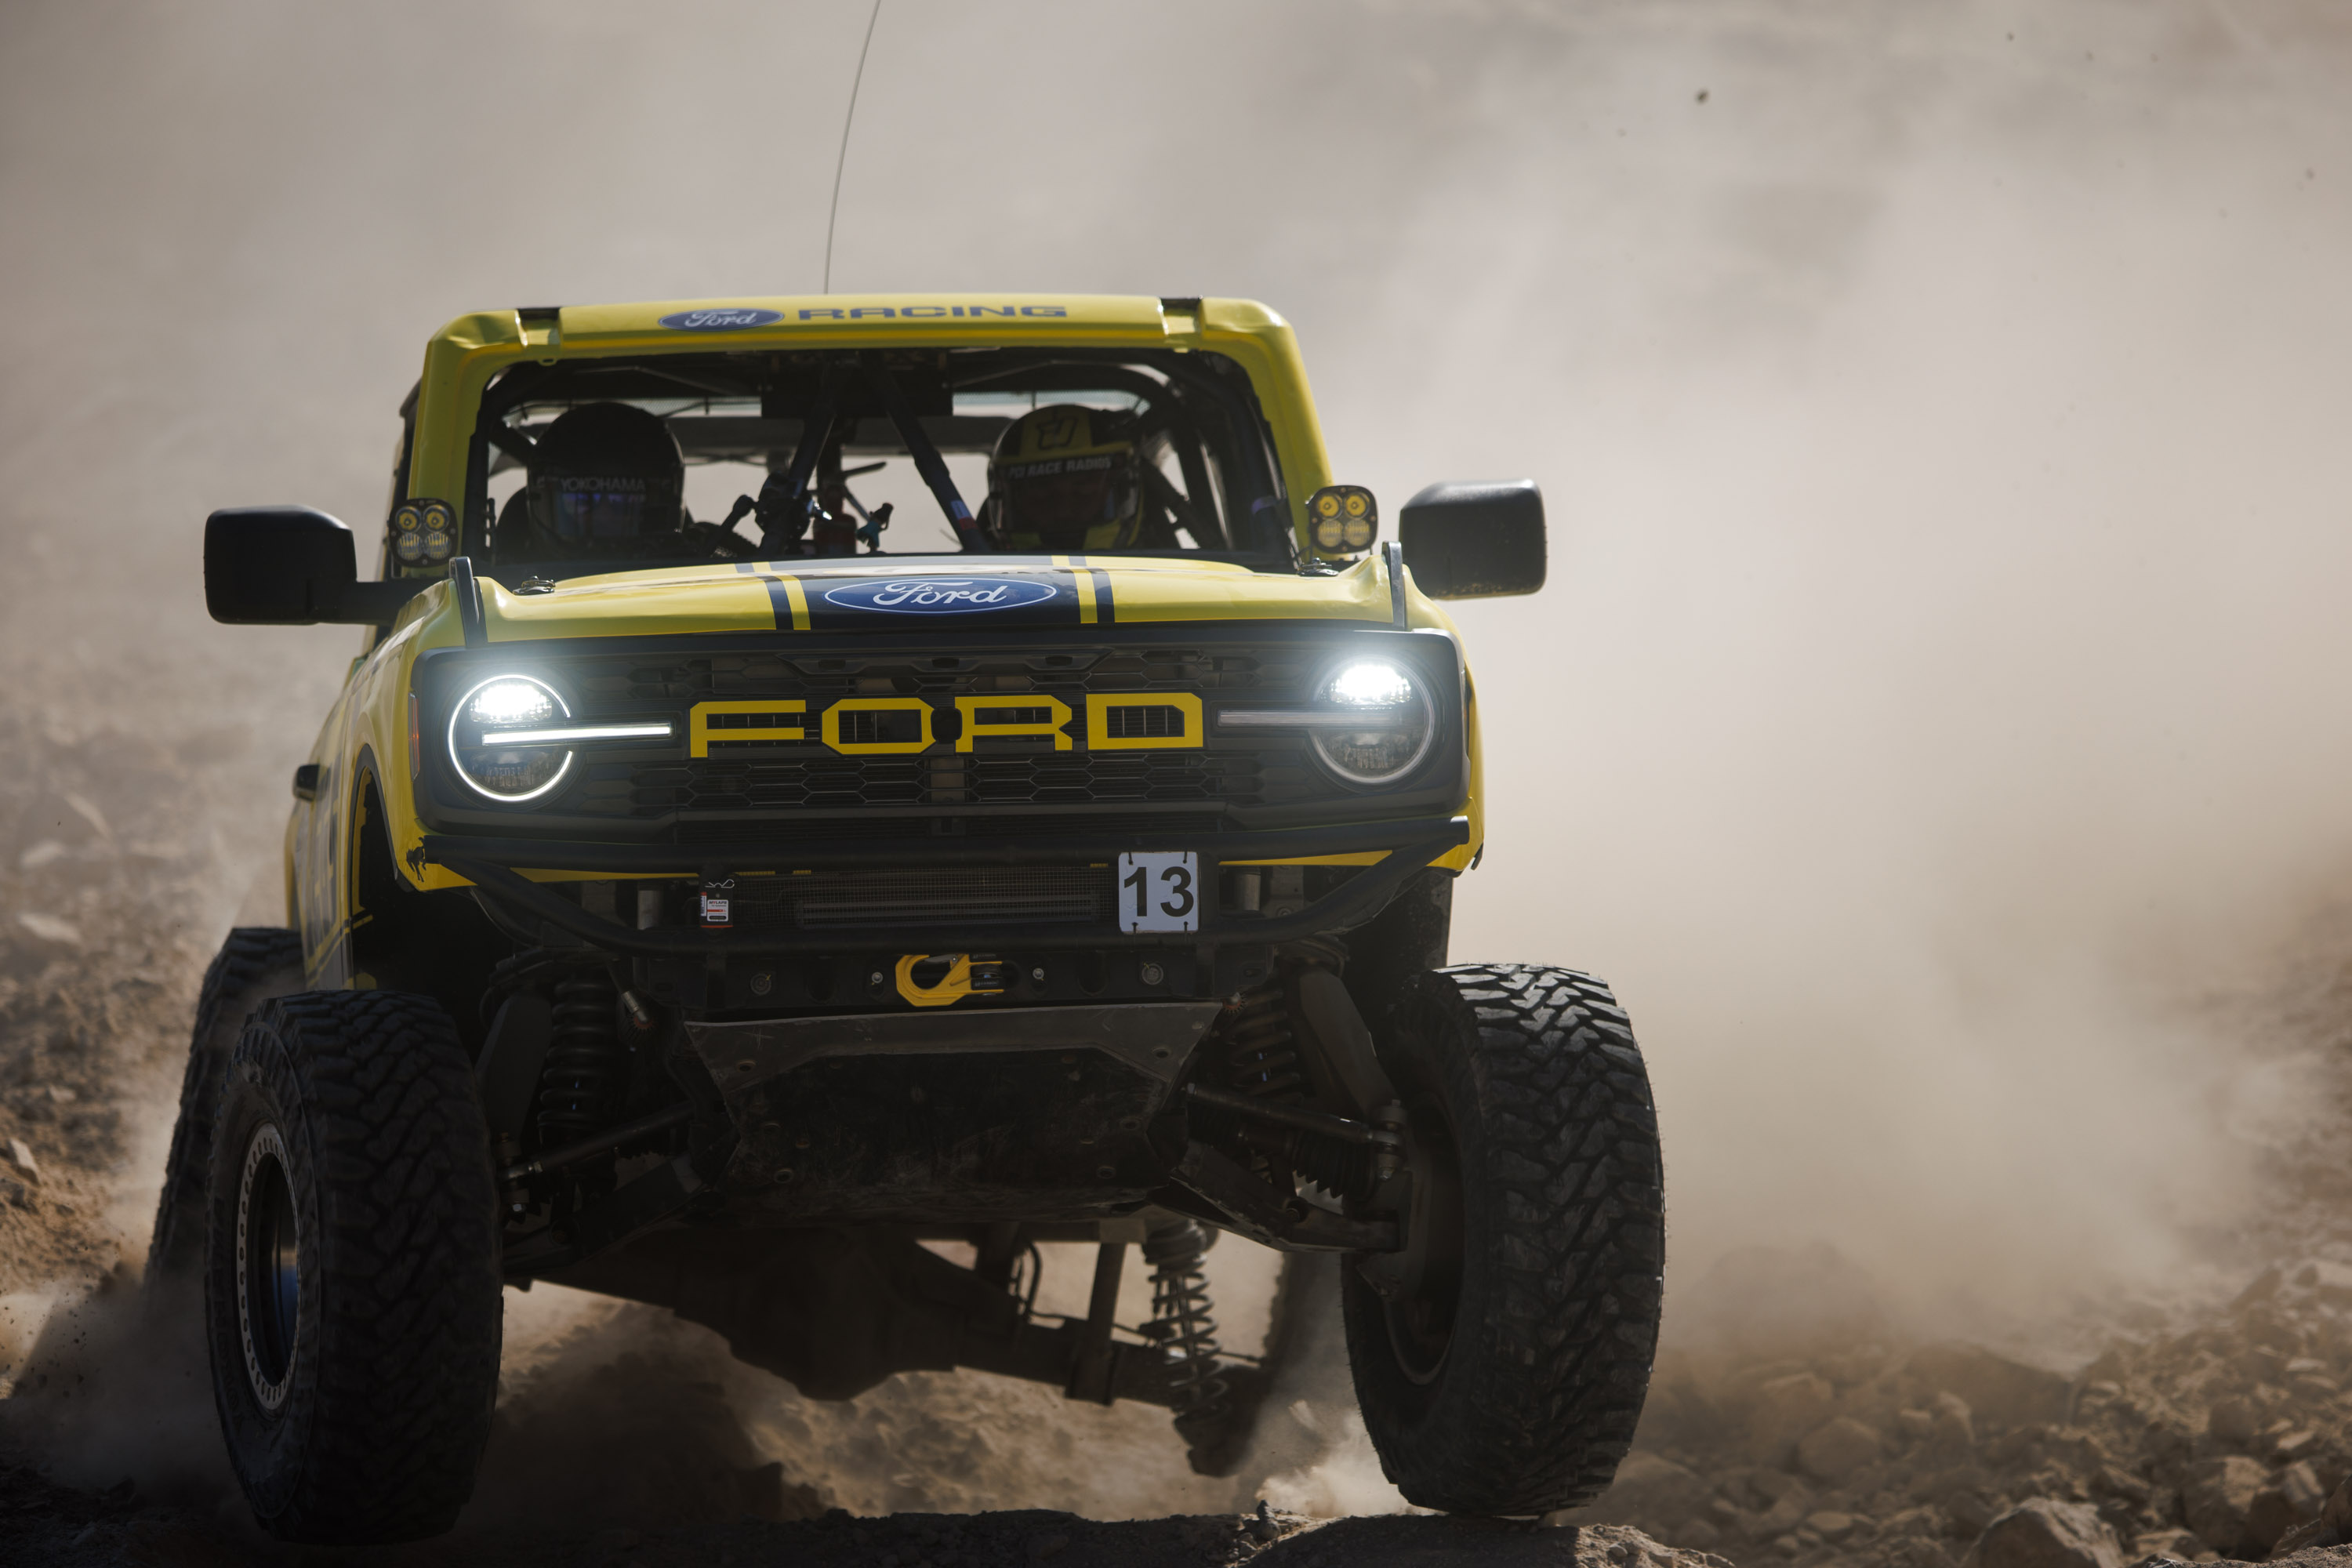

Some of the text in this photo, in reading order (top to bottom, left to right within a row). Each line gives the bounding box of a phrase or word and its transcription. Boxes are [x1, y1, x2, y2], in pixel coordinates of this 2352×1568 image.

[684, 305, 1068, 328] Ford RACING
[1027, 459, 1063, 477] RACE
[1065, 455, 1112, 474] RADIOS
[561, 477, 645, 492] YOKOHAMA
[873, 581, 1009, 605] Ford
[690, 692, 1203, 757] FORD
[1123, 866, 1194, 918] 13
